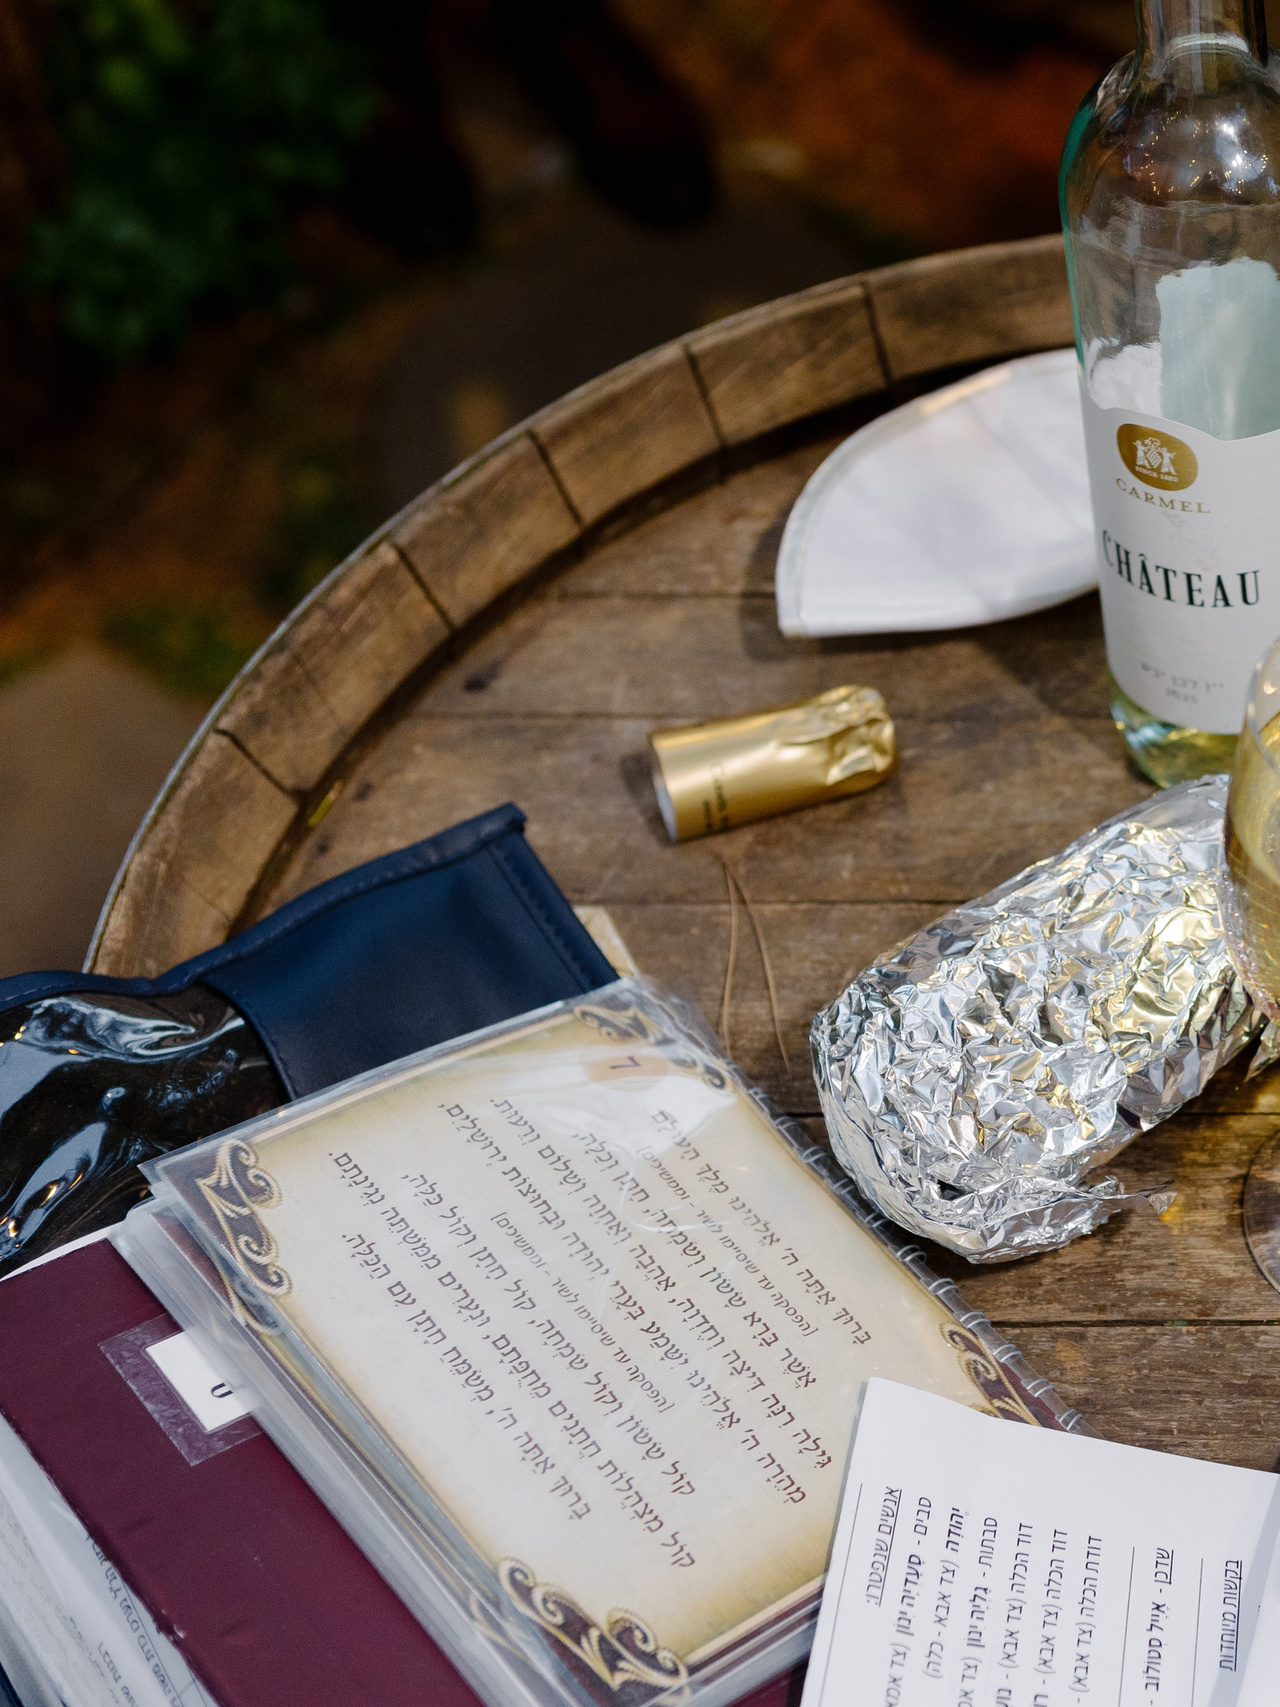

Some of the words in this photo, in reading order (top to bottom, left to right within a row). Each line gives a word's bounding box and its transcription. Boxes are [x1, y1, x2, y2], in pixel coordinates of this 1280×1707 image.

[1116, 478, 1211, 514] CARMEL
[1102, 529, 1262, 608] CHÂTEAU
[877, 1485, 899, 1537] אנשים
[1016, 1522, 1034, 1548] דוד
[1051, 1528, 1068, 1554] דוד
[1084, 1534, 1103, 1575] דודת
[865, 1537, 889, 1606] שנפטרו:
[939, 1559, 960, 1586] (צד
[1008, 1551, 1030, 1595] הכלה
[1044, 1558, 1065, 1600] הכלה
[1153, 1547, 1171, 1585] שדכן
[1223, 1559, 1242, 1608] בקשות
[933, 1590, 952, 1629] אבא
[1005, 1597, 1028, 1624] (צד
[1041, 1603, 1063, 1630] (צד
[1078, 1576, 1099, 1618] הכלה
[997, 1628, 1020, 1669] אבא)
[1033, 1634, 1056, 1675] אבא)
[1075, 1621, 1097, 1648] (צד
[1219, 1611, 1237, 1671] מיוחדות
[922, 1640, 944, 1679] כלה)
[1068, 1652, 1091, 1693] אבא)
